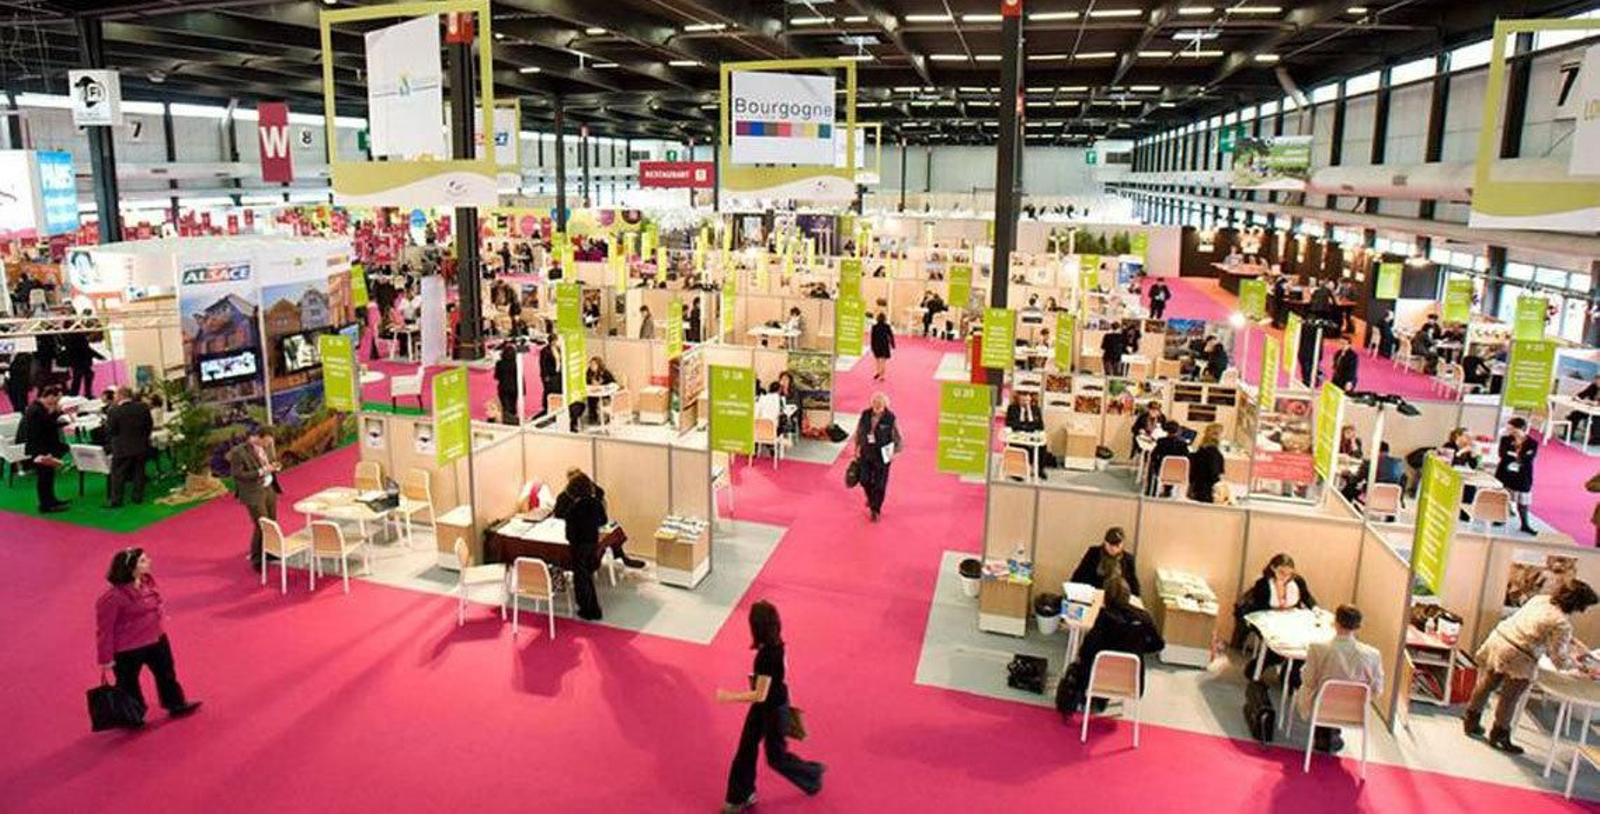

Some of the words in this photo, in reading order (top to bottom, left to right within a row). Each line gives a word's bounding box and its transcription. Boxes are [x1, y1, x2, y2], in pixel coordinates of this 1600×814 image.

[1558, 61, 1581, 107] 7
[734, 98, 833, 119] Bourgogne
[259, 125, 290, 159] W
[183, 265, 250, 284] ALSACE
